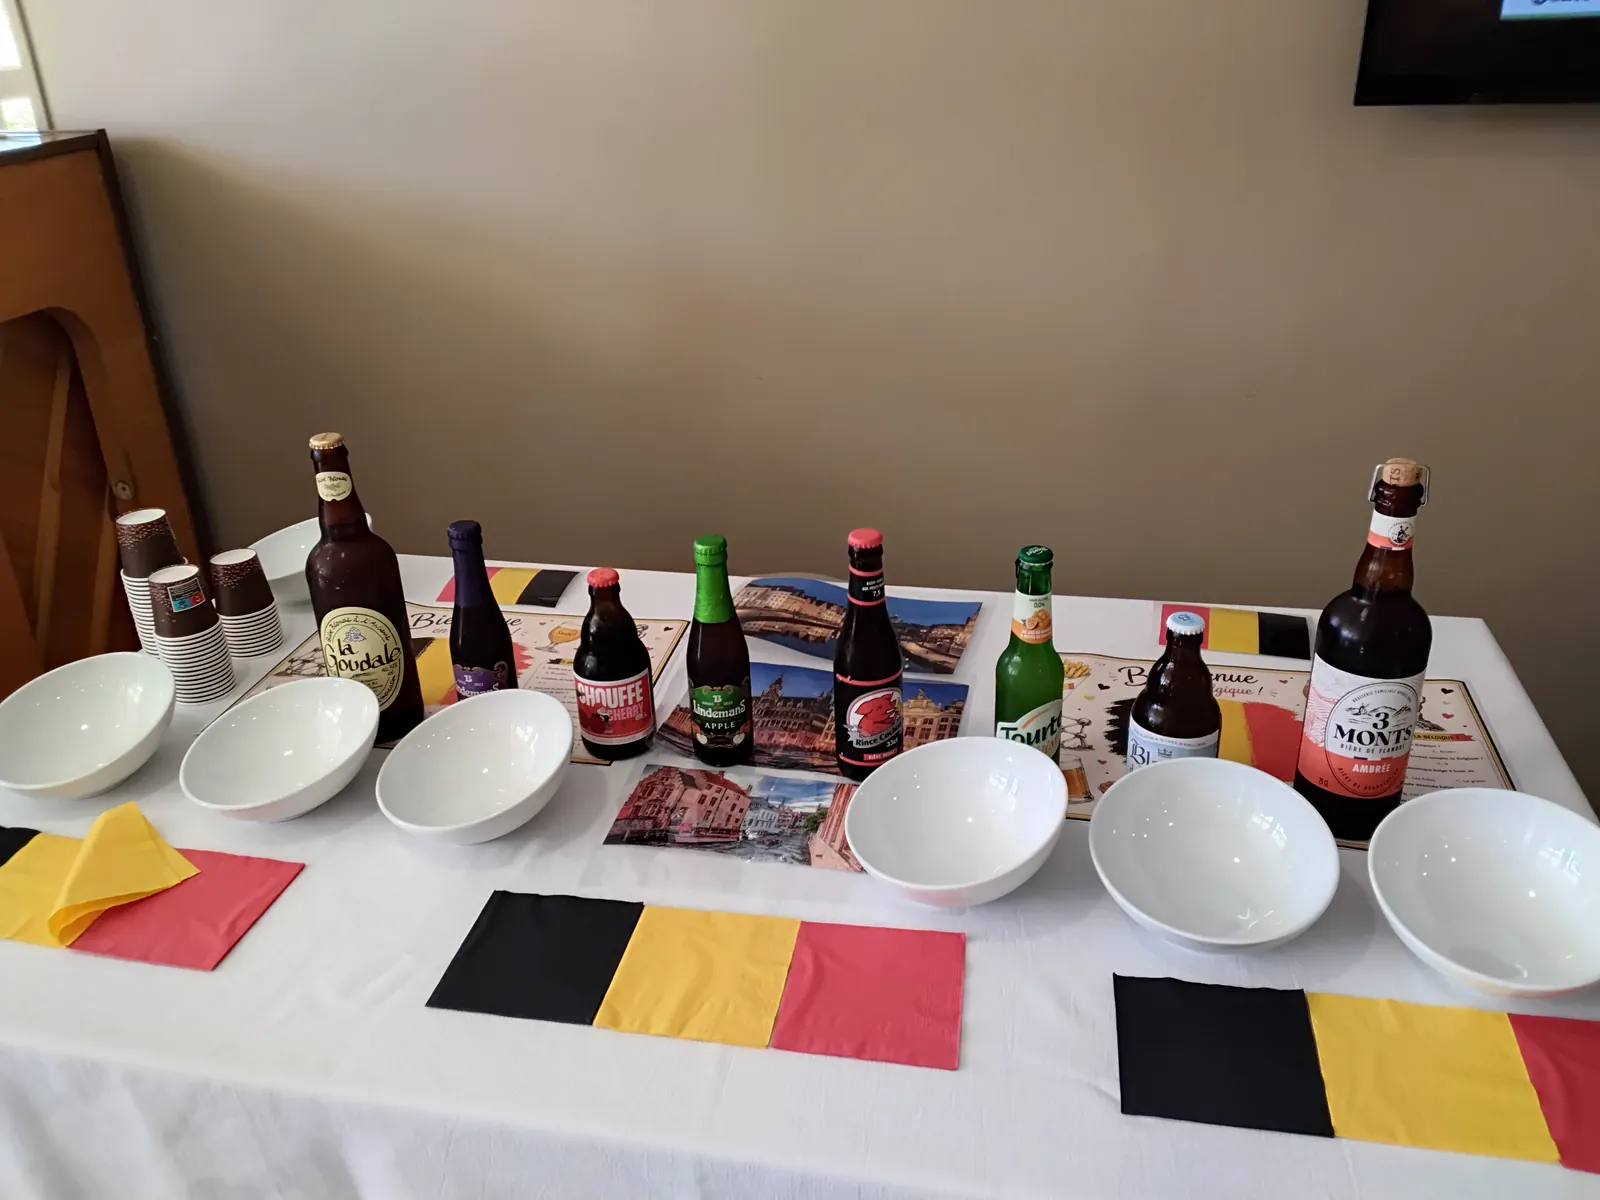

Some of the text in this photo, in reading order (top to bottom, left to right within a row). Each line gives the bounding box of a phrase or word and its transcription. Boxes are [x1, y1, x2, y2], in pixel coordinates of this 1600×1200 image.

[337, 638, 359, 656] la
[577, 680, 644, 709] CHOUFFE
[608, 703, 645, 721] CHERRY
[1372, 712, 1390, 730] 3
[704, 721, 736, 730] APPLE
[1000, 711, 1062, 745] Tourte
[856, 737, 878, 747] Rince
[1333, 723, 1413, 747] MONTS
[1340, 743, 1362, 753] BIÈRE
[1352, 763, 1392, 774] AMBRÉE
